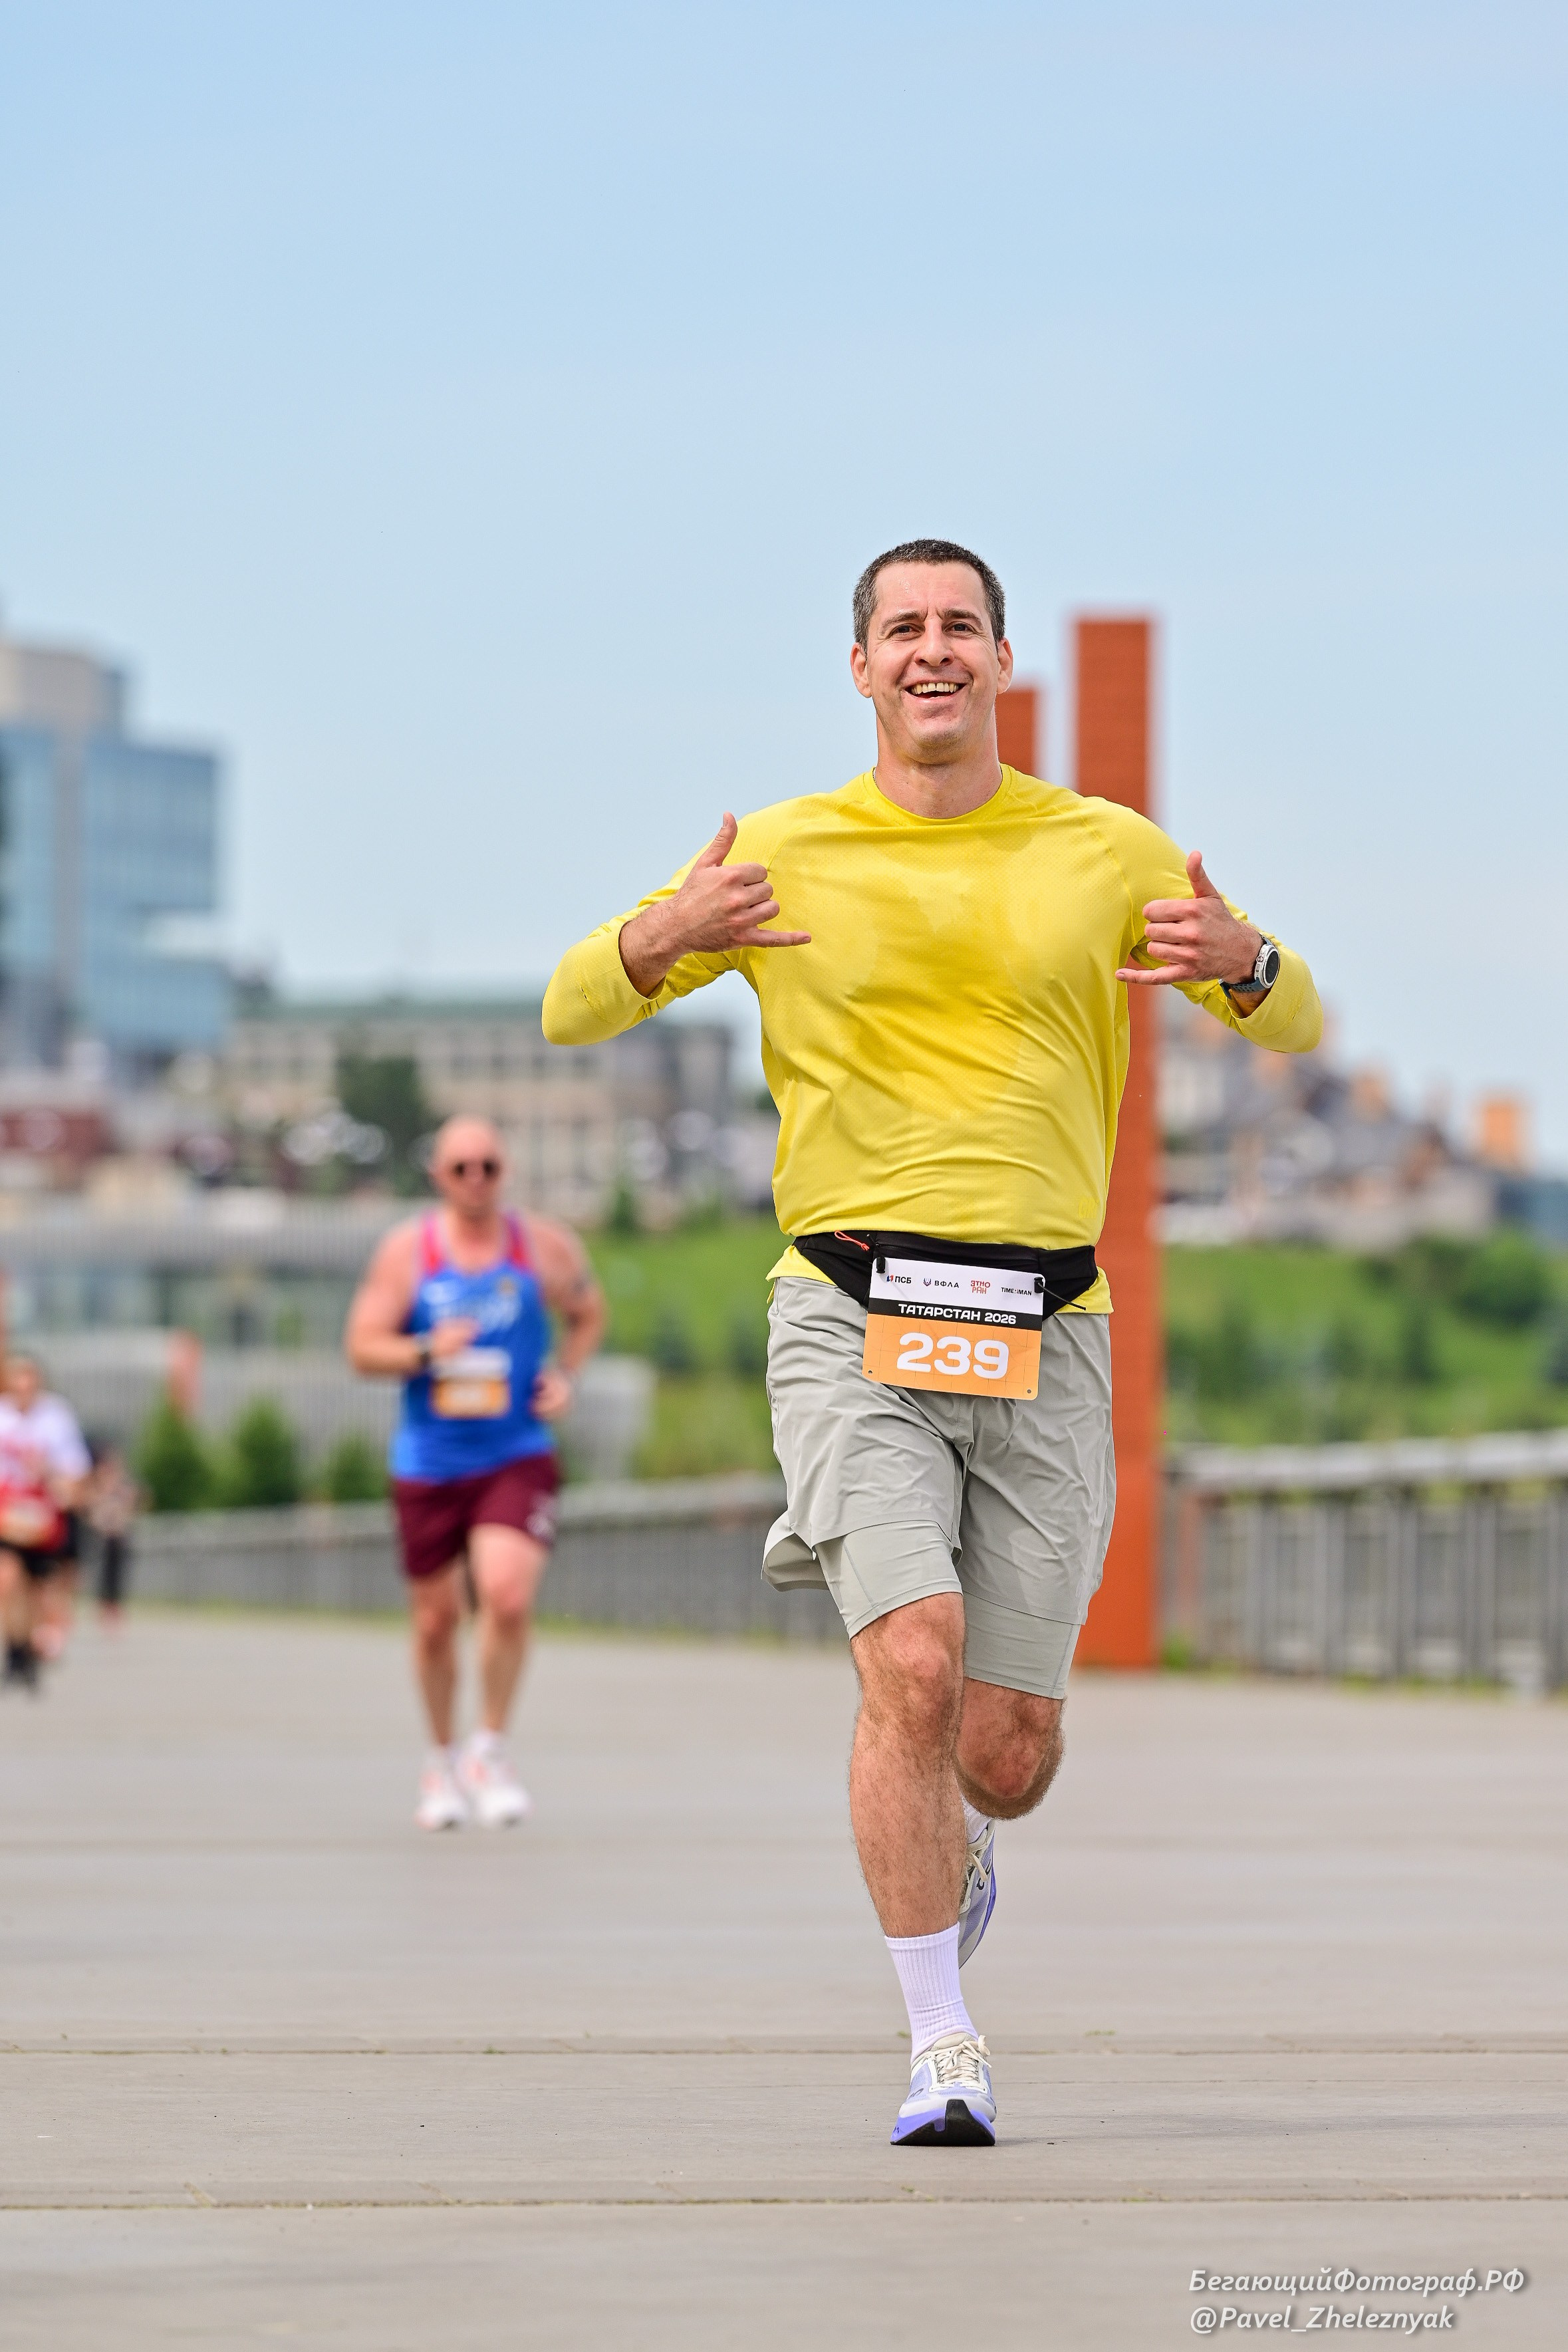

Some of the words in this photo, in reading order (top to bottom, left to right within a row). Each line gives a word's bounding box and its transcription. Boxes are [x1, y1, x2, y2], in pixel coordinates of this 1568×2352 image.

[894, 1275, 912, 1284] ПСБ
[972, 1286, 987, 1295] РАН
[898, 1303, 981, 1321] ТАТАРСТАН
[984, 1312, 1017, 1325] 2026
[896, 1332, 1009, 1379] 239
